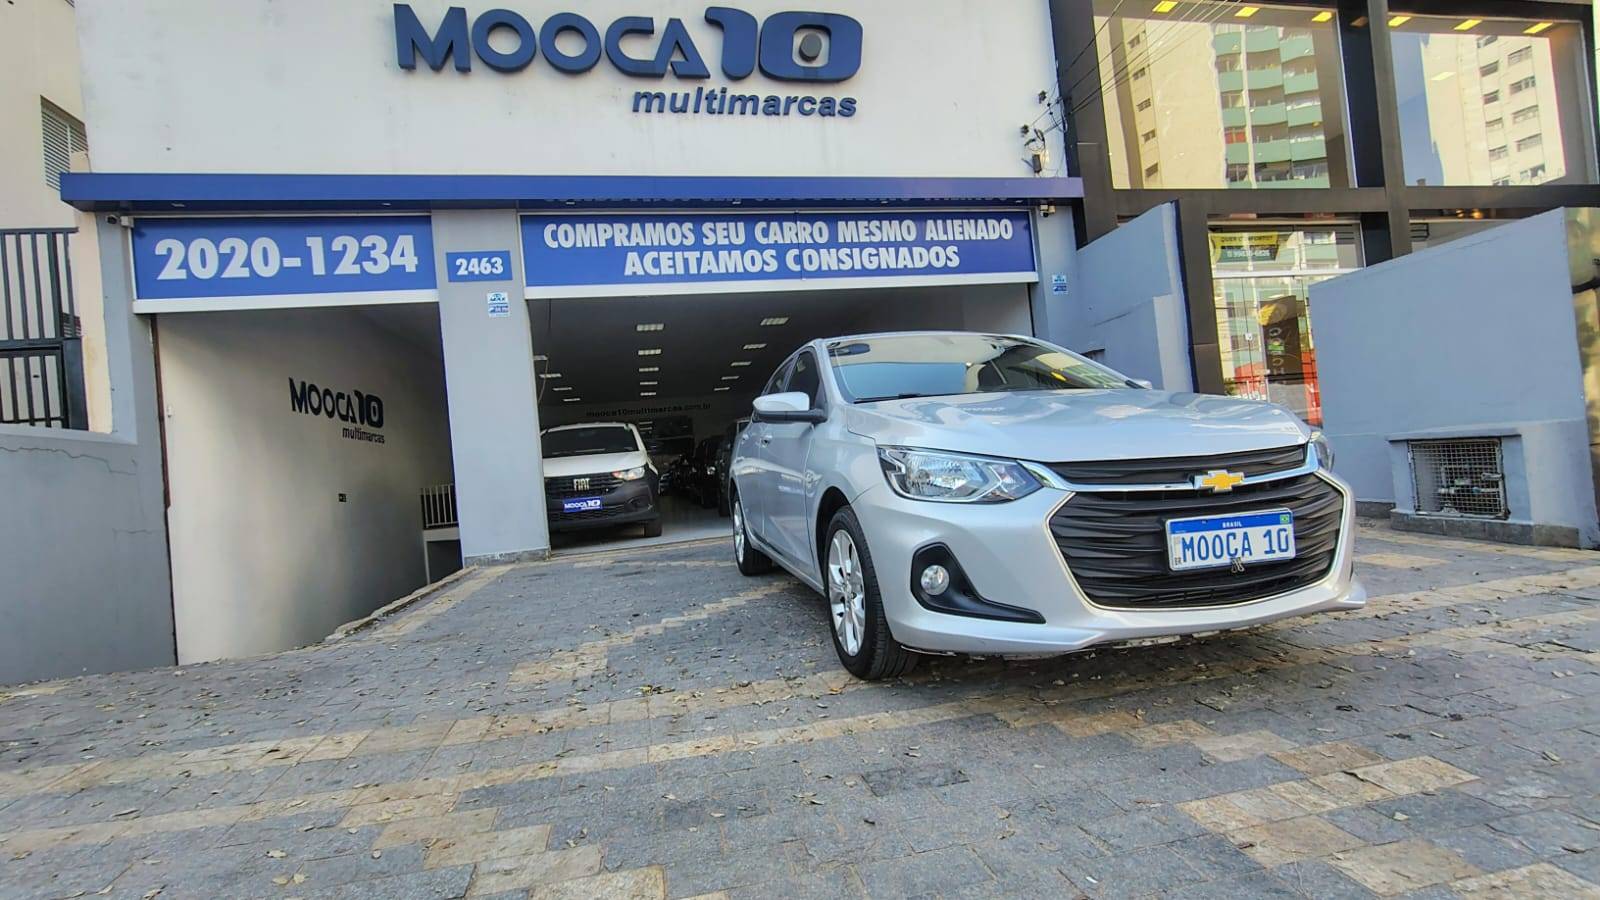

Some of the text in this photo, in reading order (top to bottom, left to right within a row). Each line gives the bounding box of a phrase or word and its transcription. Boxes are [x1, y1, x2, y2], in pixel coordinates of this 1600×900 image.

[632, 87, 857, 117] multimarcas
[543, 218, 1013, 248] COMPRAMOS SEU CARRO MESMO ALIENADO
[155, 234, 418, 281] 2020-1234
[455, 256, 504, 276] 2463
[624, 246, 961, 276] ACEITAMOS CONSIGNADOS
[342, 427, 385, 444] multimarcas
[573, 478, 590, 491] FIAT
[1181, 528, 1290, 562] MOOCA 10
